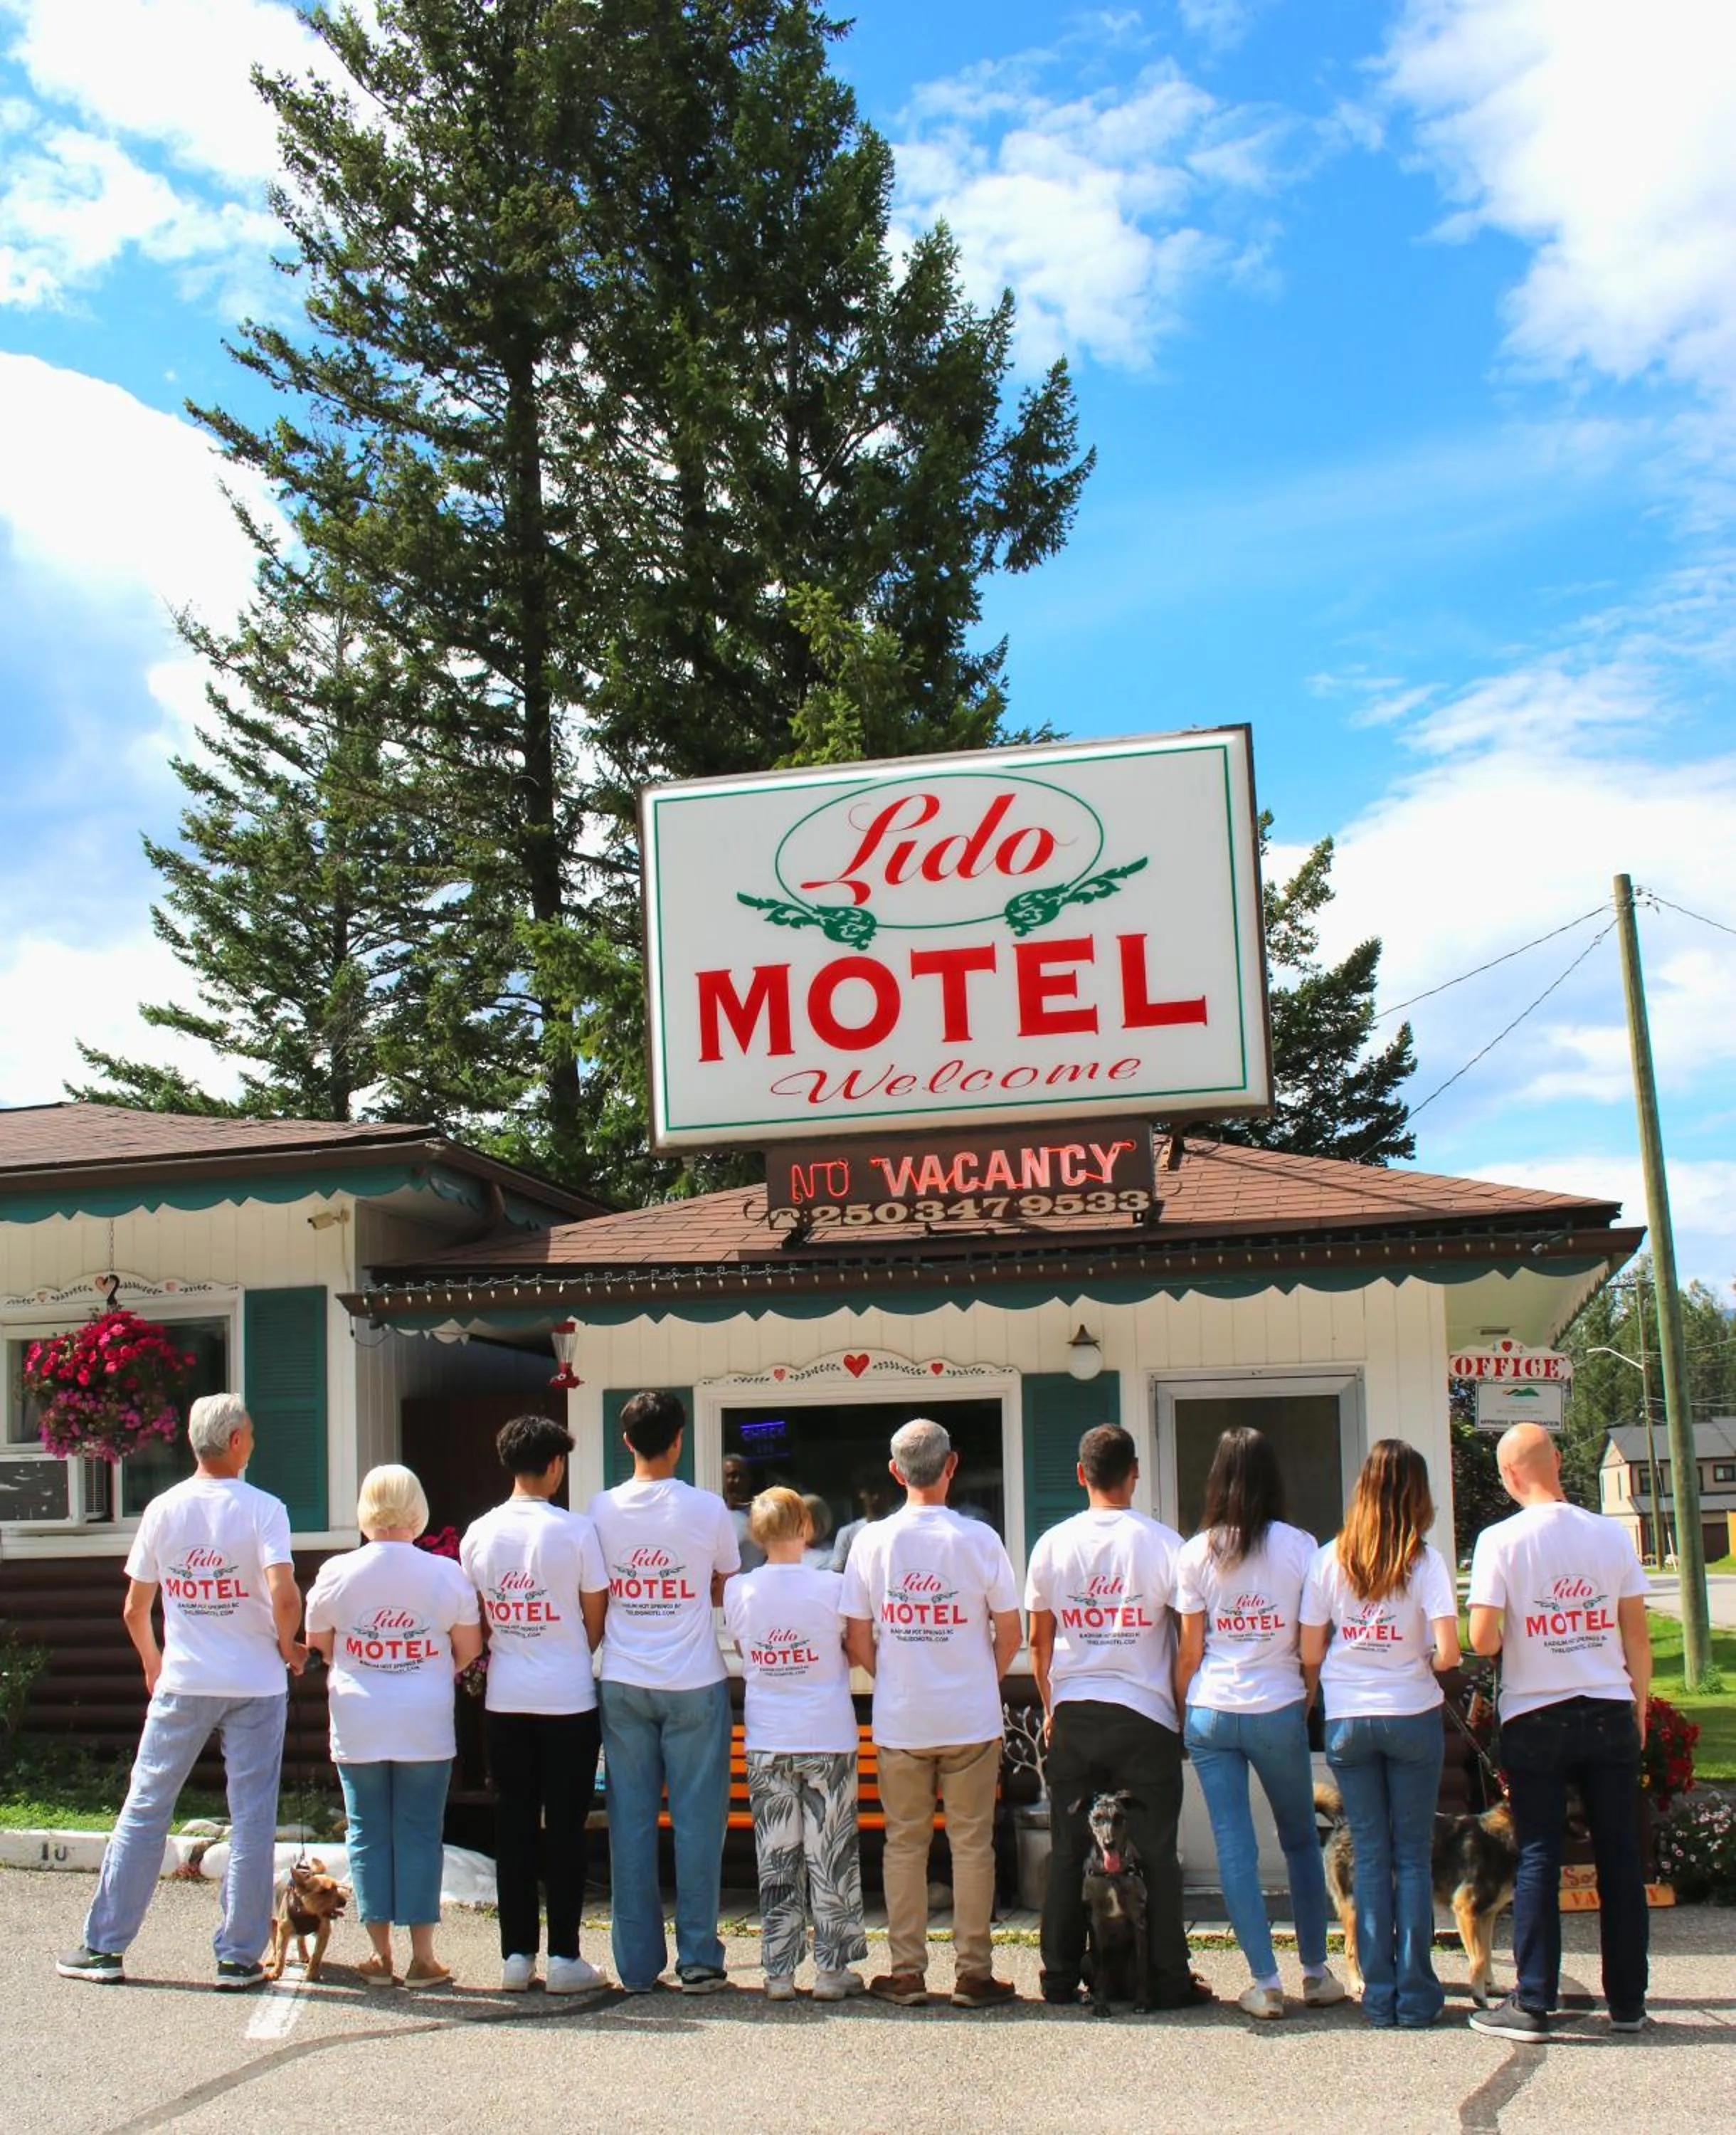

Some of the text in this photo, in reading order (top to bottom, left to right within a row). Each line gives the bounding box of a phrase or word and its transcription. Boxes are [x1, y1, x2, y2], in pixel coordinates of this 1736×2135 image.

[801, 794, 1078, 905] Lido
[694, 933, 1208, 1062] MOTEL
[771, 1058, 1143, 1105] Welcome
[791, 1140, 1136, 1204] NO VACANCY
[1455, 1356, 1565, 1380] OFFICE
[179, 1548, 223, 1570] Lido
[624, 1548, 669, 1569] Lido
[166, 1578, 249, 1600] MOTEL
[500, 1571, 535, 1592] Lido
[610, 1578, 696, 1599] MOTEL
[895, 1572, 941, 1593] Lido
[1546, 1578, 1593, 1601] Lido
[364, 1610, 415, 1630] Lido
[882, 1603, 968, 1625] MOTEL
[1061, 1608, 1153, 1628] MOTEL
[1217, 1614, 1286, 1632] MOTEL
[1525, 1609, 1614, 1638] MOTEL
[346, 1638, 439, 1660] MOTEL
[751, 1648, 820, 1665] MOTEL
